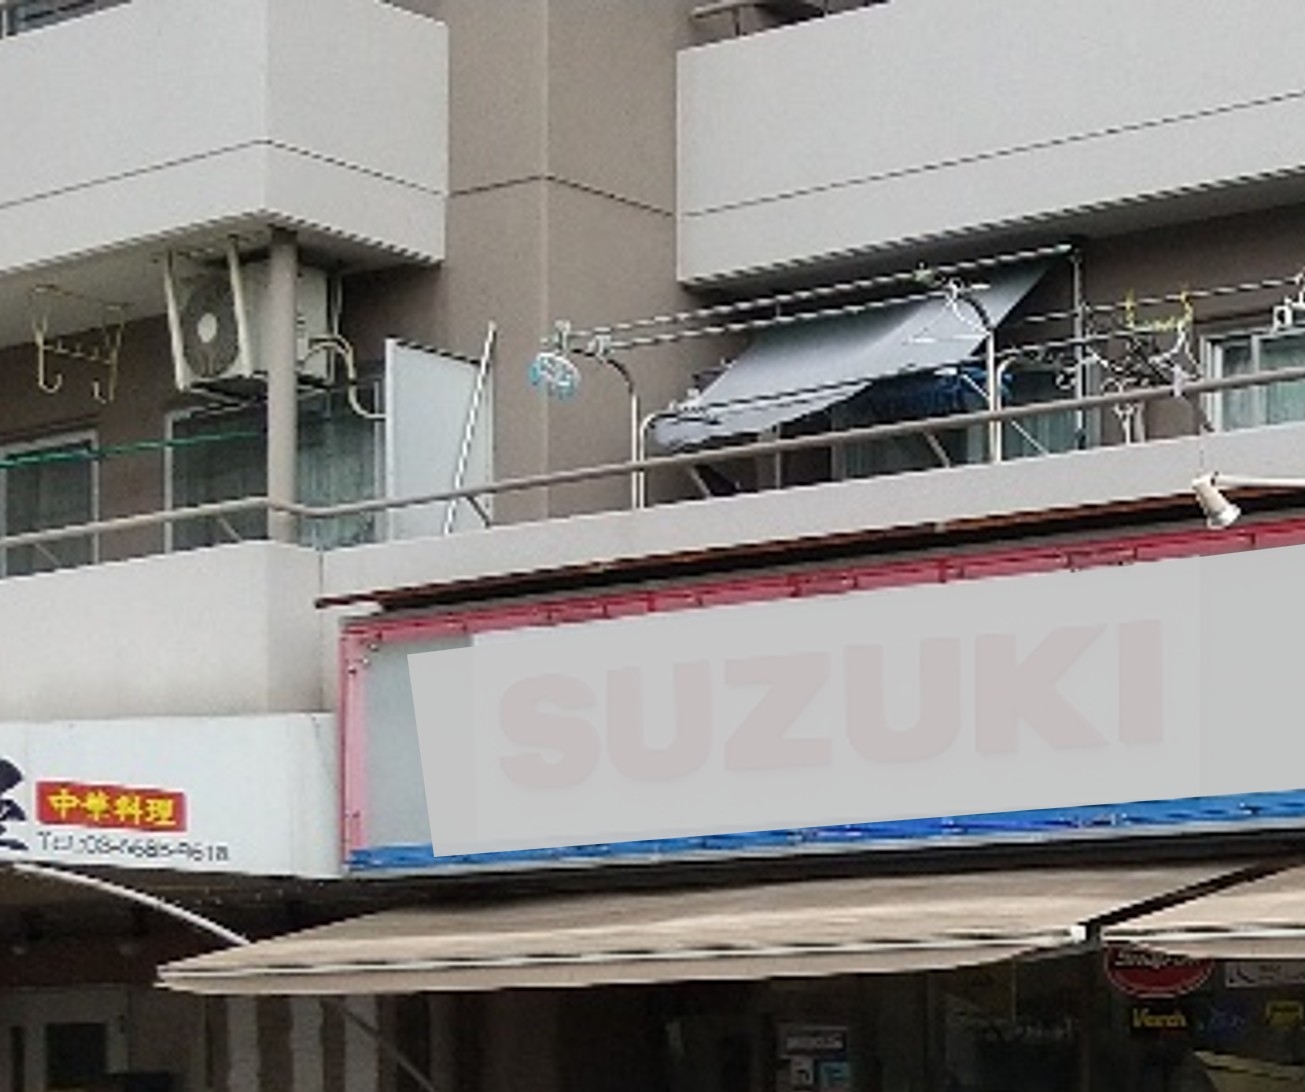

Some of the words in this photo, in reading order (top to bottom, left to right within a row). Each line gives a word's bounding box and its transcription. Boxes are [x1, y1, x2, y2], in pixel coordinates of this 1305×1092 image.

[497, 617, 1166, 792] SUZUKI
[47, 788, 177, 827] 中華料理
